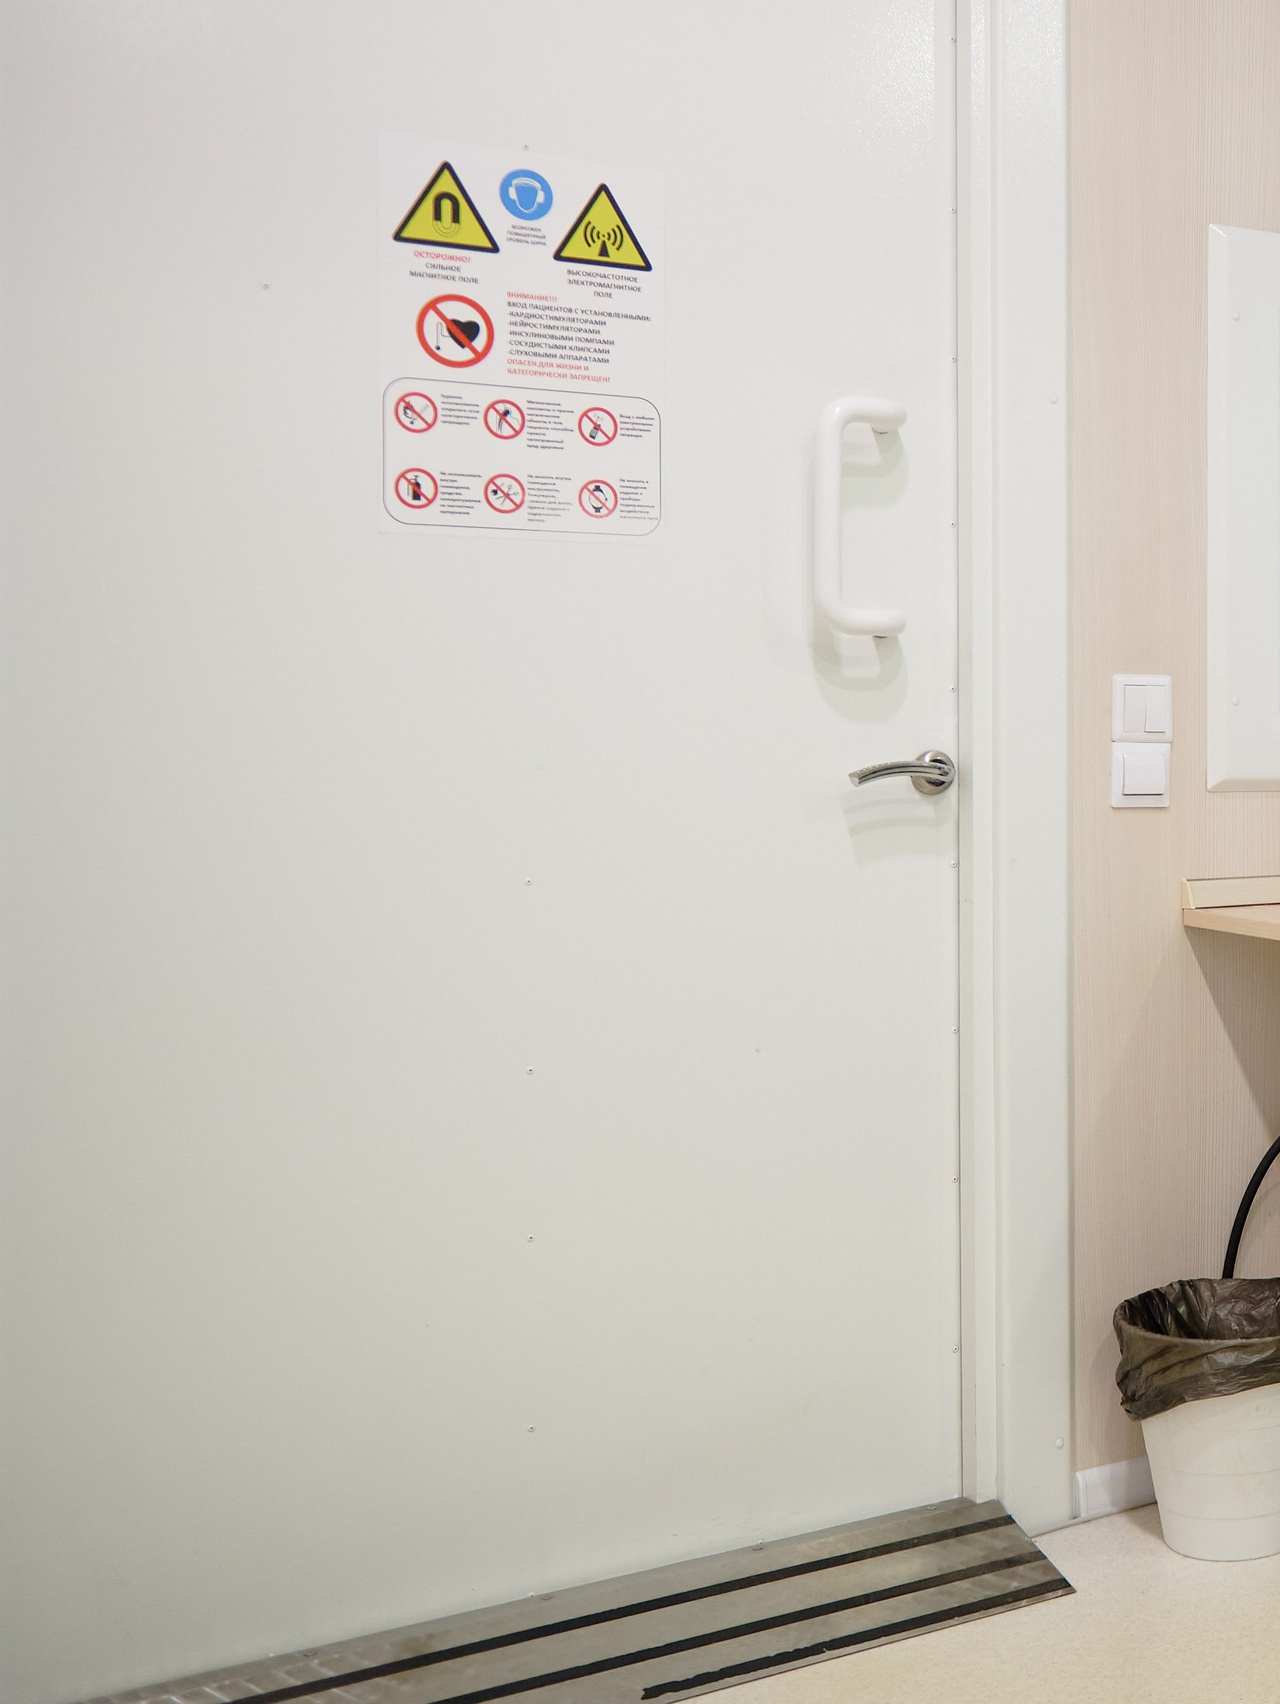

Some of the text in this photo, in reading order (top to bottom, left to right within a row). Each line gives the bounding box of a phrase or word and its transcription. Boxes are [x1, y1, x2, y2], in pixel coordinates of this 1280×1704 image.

[414, 250, 470, 262] ОСТОРОЖНО!
[425, 262, 460, 272] СИЛЬНОЕ
[409, 270, 478, 284] МАГНИТНОЕ ПОЛЕ
[566, 269, 638, 282] ВЫСОКОЧАСТОТНОЕ
[568, 278, 642, 292] ЭЛЕКТРОМАГНИТНОЕ
[507, 291, 558, 302] ВНИМАНИЕ!!!
[507, 301, 528, 309] ВХОД
[529, 303, 573, 314] ПАЦИЕНТОВ
[580, 309, 652, 322] УСТАНОВЛЕННЫМИ:
[575, 336, 614, 345] ПОМПАМИ
[568, 345, 610, 354] КЛИПСАМИ
[507, 358, 536, 366] ОПАСЕН
[559, 354, 610, 364] АППАРАТАМИ
[507, 368, 610, 383] КАТЕГОРИЧЕСКИ ЗАПРЕЩЕН!
